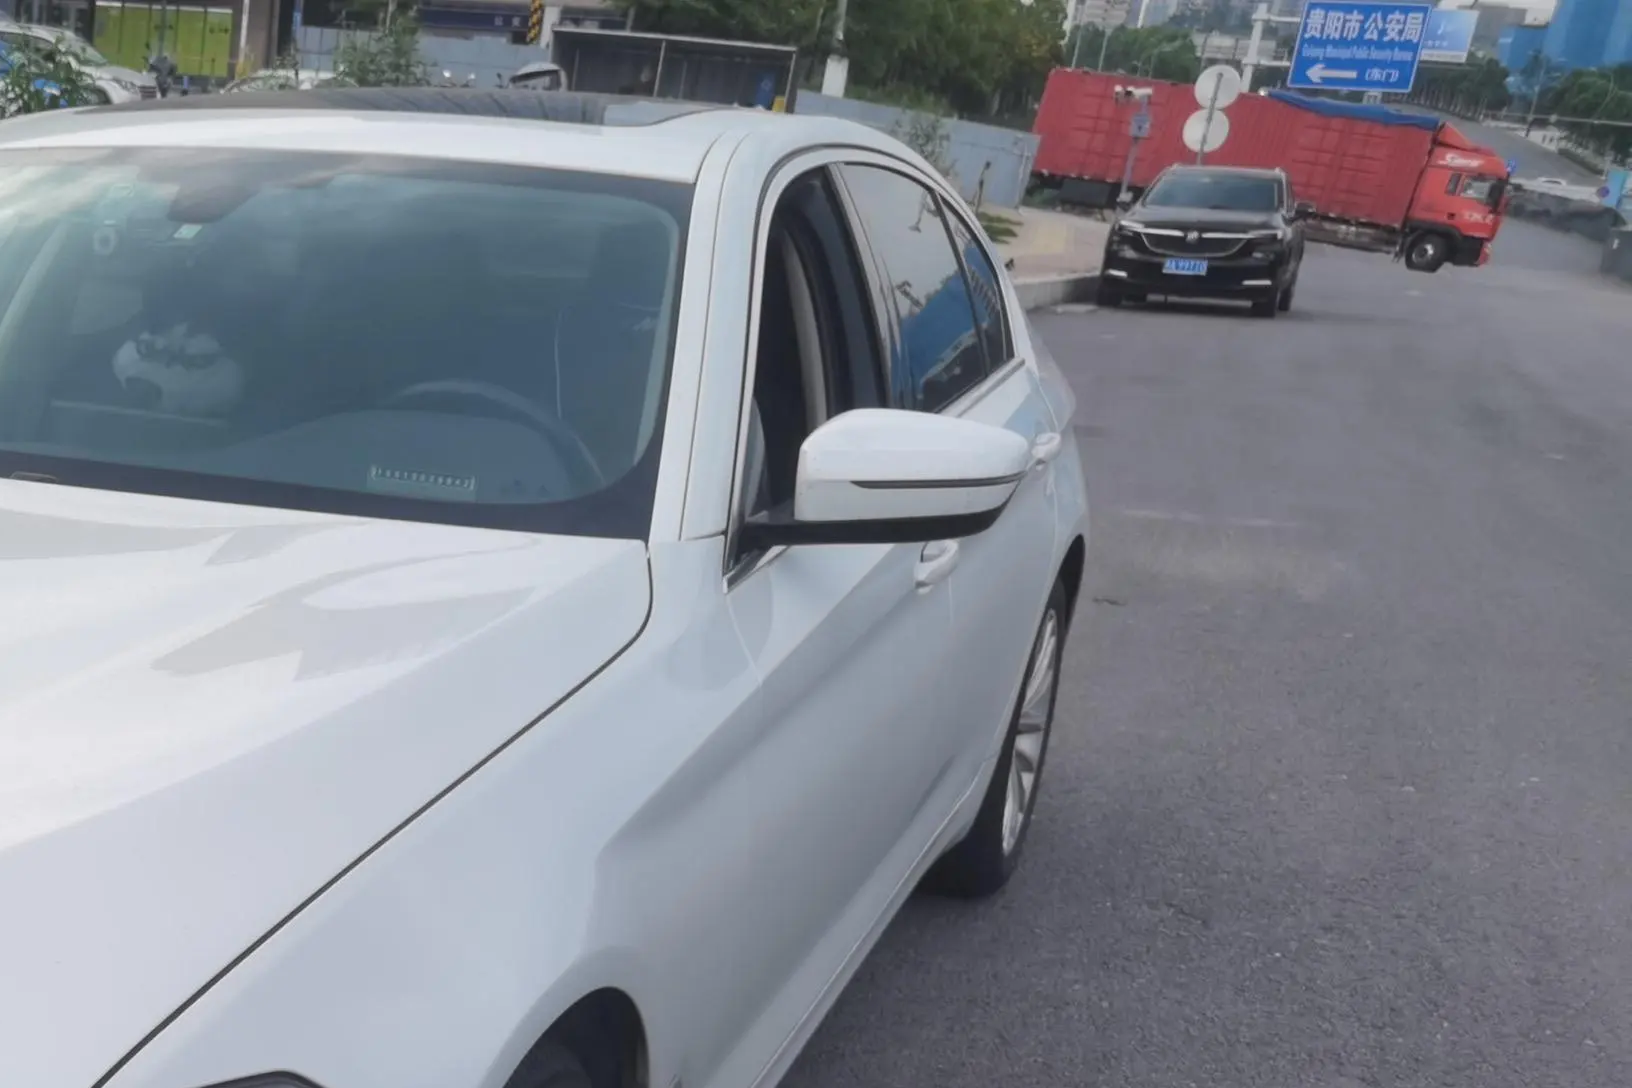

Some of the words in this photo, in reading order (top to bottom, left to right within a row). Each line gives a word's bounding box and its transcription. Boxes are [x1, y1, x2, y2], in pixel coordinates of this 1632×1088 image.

[1304, 8, 1424, 43] 贵阳市公安局
